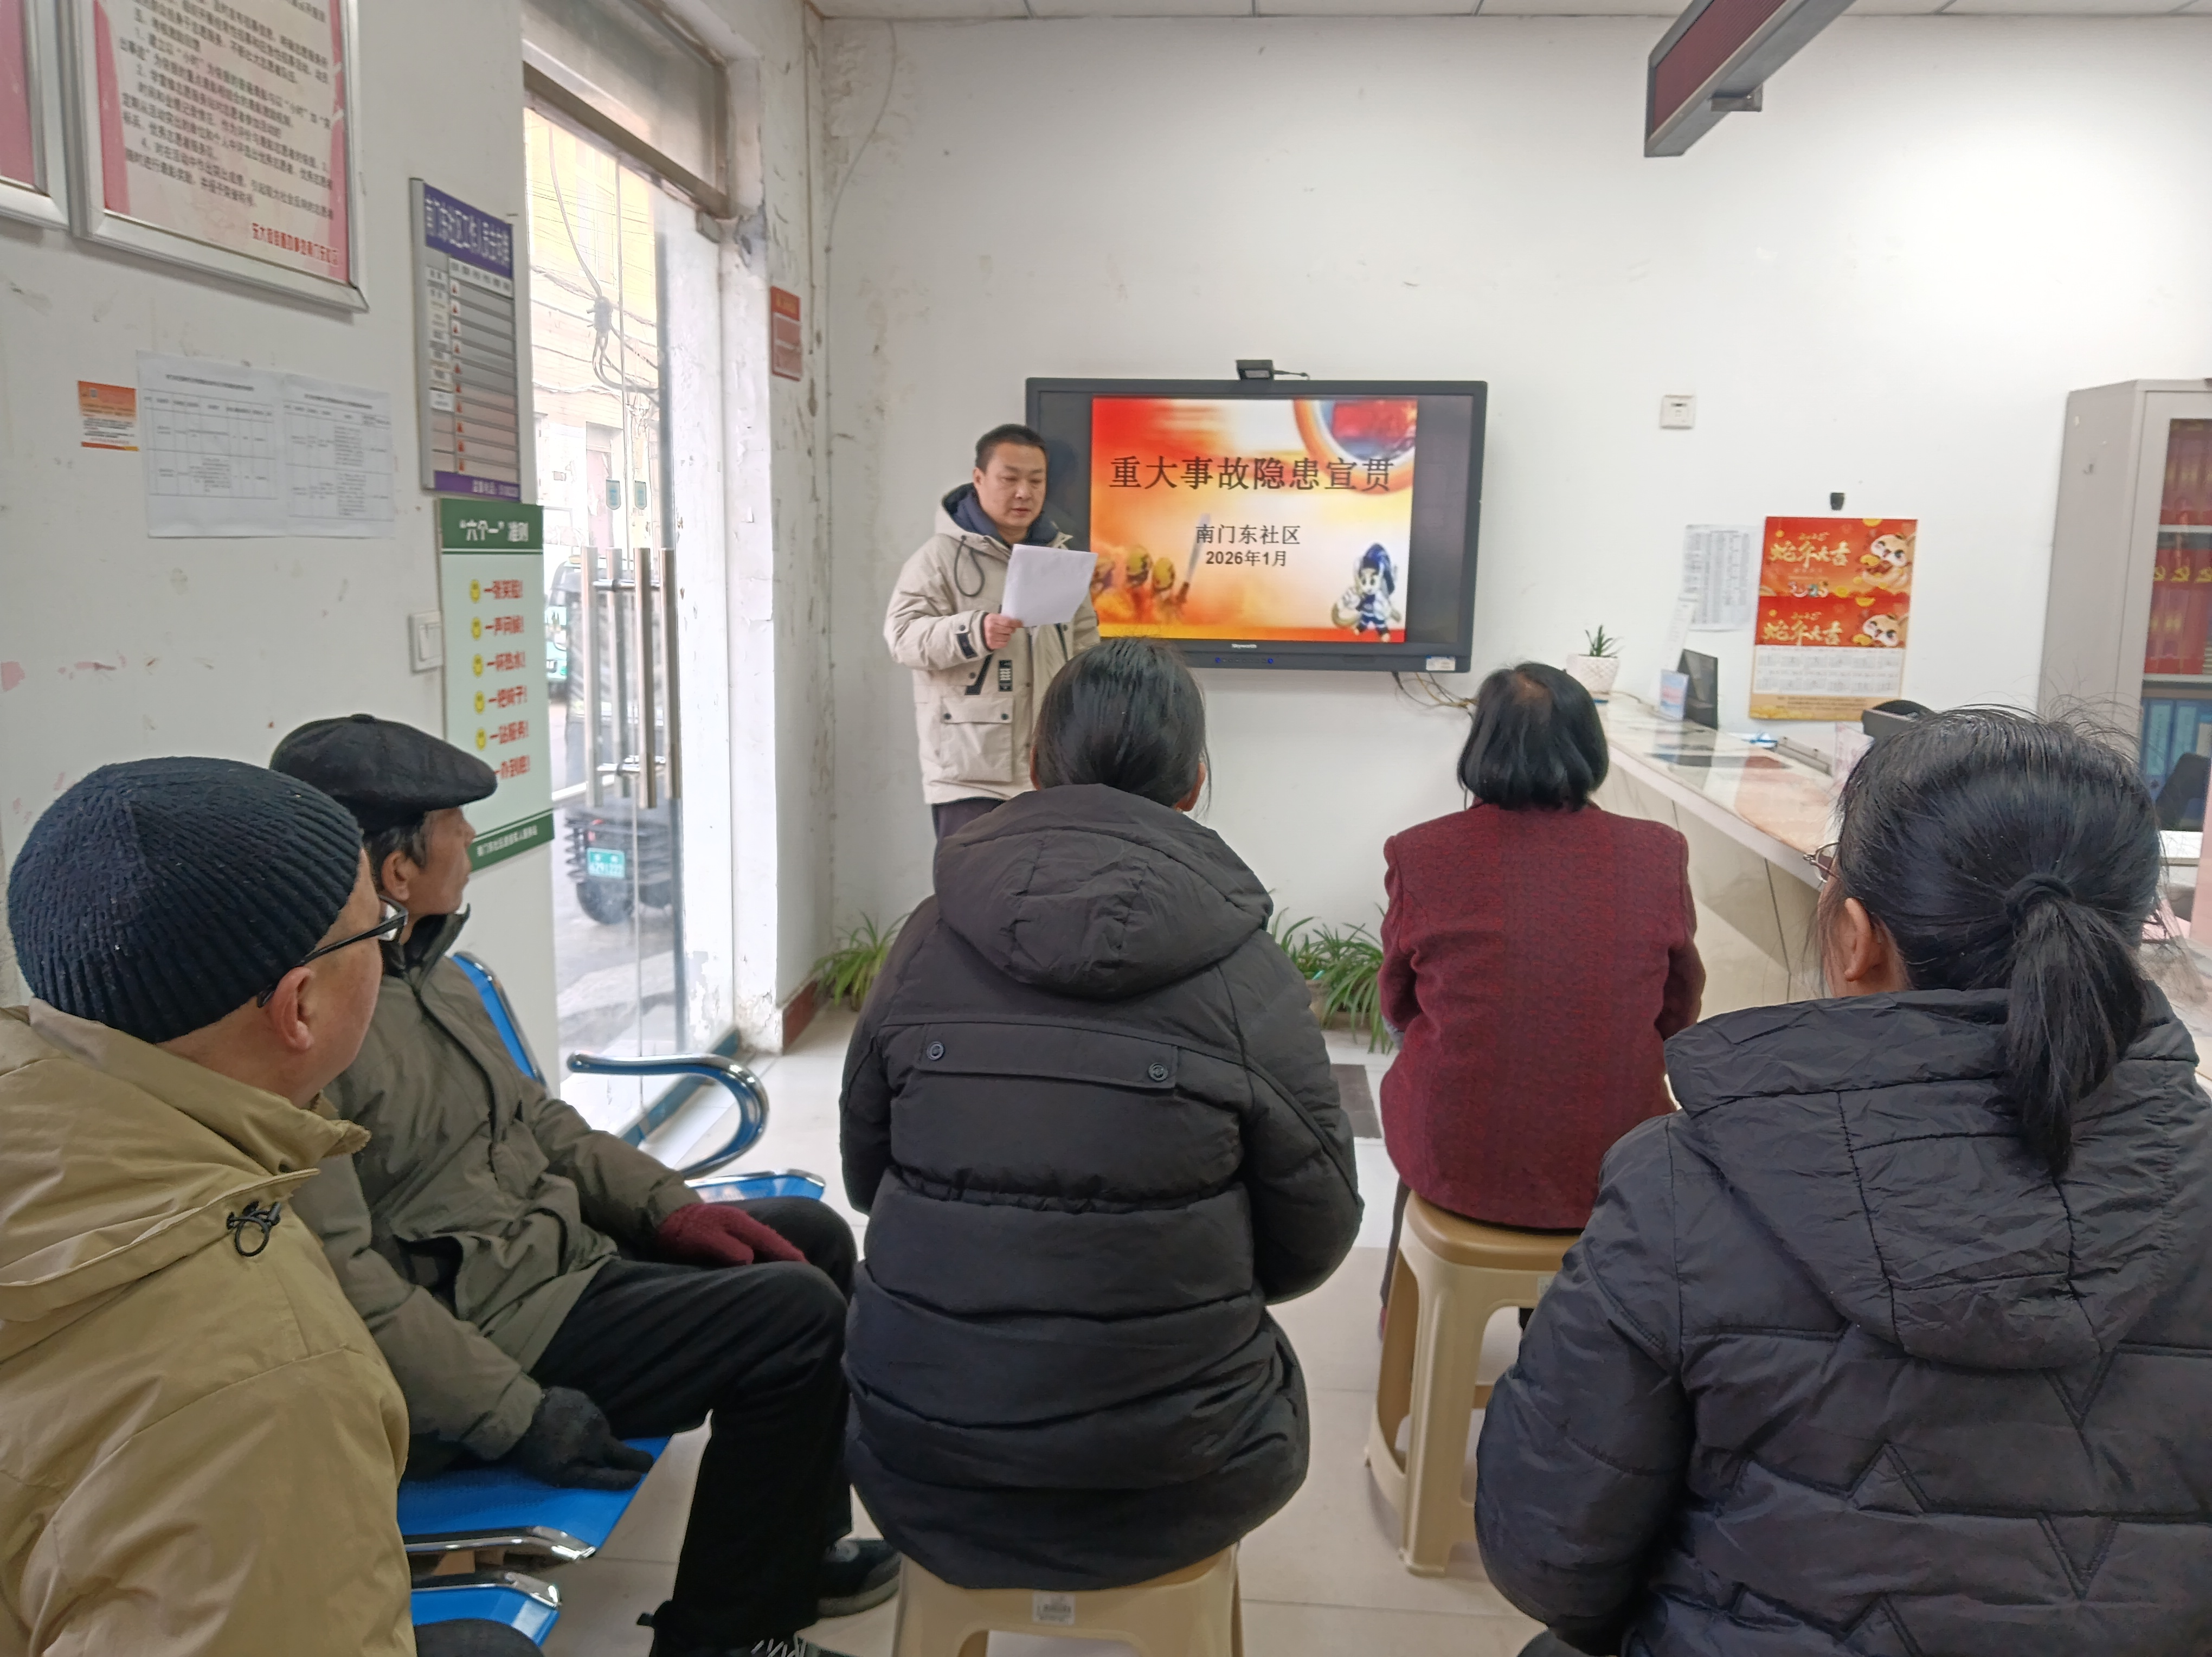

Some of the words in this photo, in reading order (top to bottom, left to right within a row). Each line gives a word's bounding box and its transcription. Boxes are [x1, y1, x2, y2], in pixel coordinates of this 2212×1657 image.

[1109, 455, 1394, 491] 重大事故隐患宣贯
[1195, 524, 1300, 544] 南门东社区
[1205, 549, 1286, 566] 2026年1月
[1770, 540, 1851, 569] 蛇年大吉
